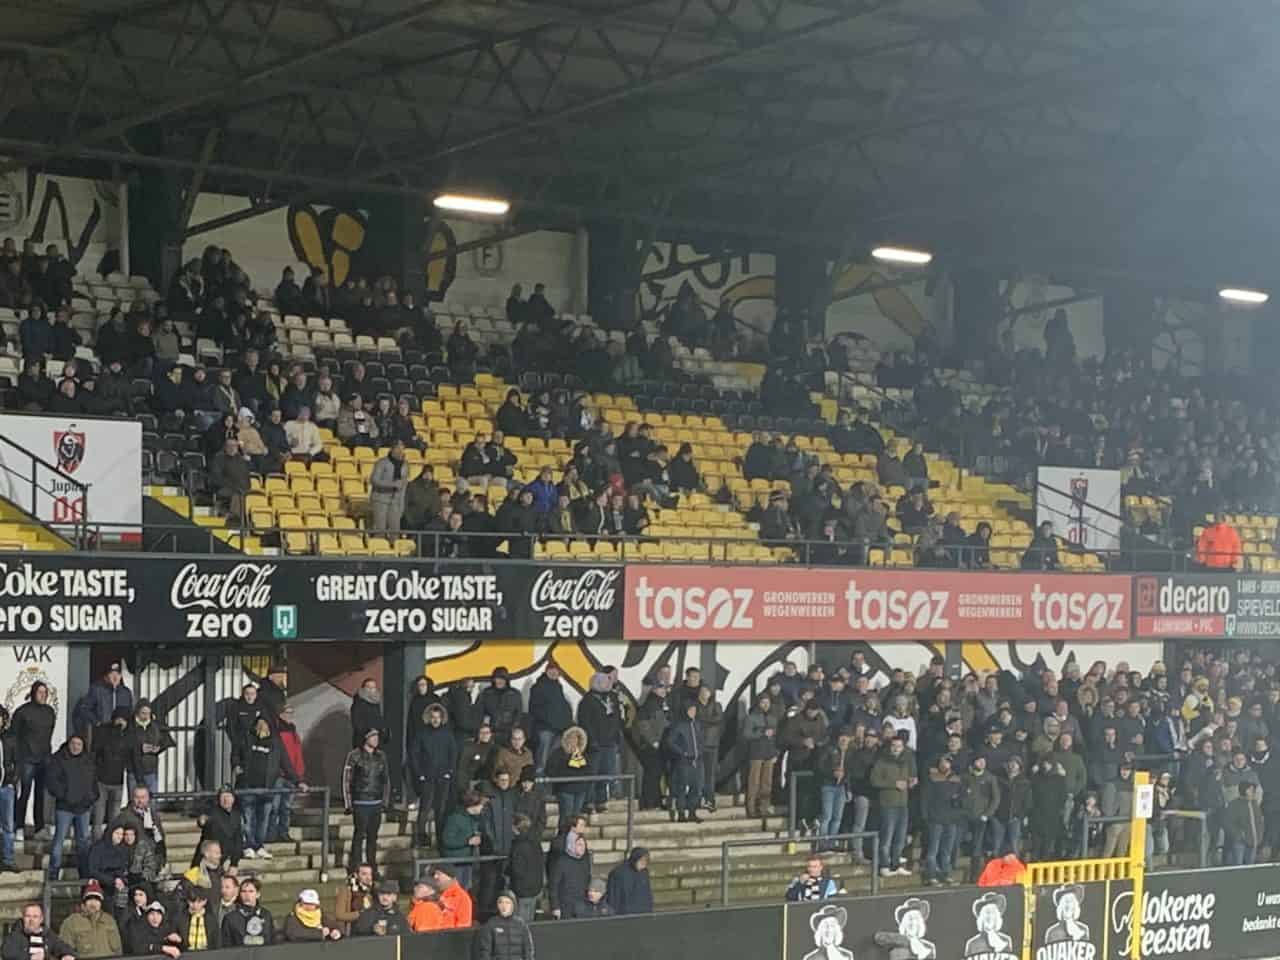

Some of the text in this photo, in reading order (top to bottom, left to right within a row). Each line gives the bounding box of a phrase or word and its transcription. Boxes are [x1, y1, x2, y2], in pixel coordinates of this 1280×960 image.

[60, 569, 135, 602] TASTE,
[171, 562, 276, 610] Coca-Cola
[316, 569, 503, 606] GREAT Coke TASTE,
[530, 568, 619, 612] Coca-Cola
[1159, 577, 1230, 614] decaro
[51, 604, 122, 632] SUGAR
[186, 612, 252, 638] zero
[365, 607, 493, 633] zero SUGAR
[543, 615, 599, 638] zero
[13, 645, 52, 663] VAK
[1140, 923, 1212, 956] eesten
